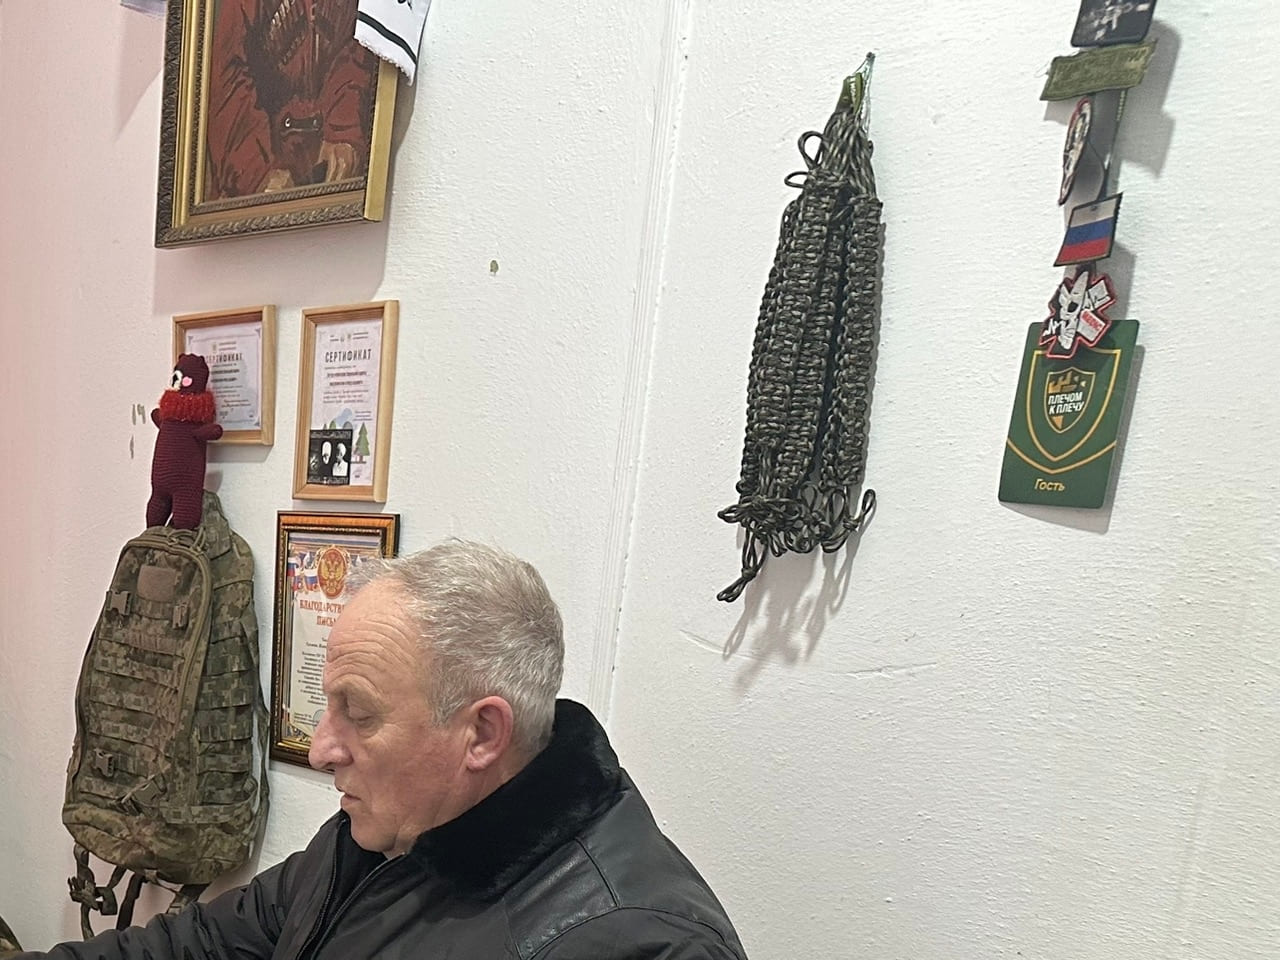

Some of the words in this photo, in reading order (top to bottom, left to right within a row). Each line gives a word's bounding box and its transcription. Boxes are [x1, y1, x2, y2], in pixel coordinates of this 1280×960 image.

[325, 348, 372, 363] СЕРТИФИКАТ
[1048, 391, 1083, 405] ПЛЕЧОМ
[1049, 405, 1057, 415] К
[1056, 402, 1084, 415] ПЛЕЧУ
[1034, 478, 1066, 492] Гость
